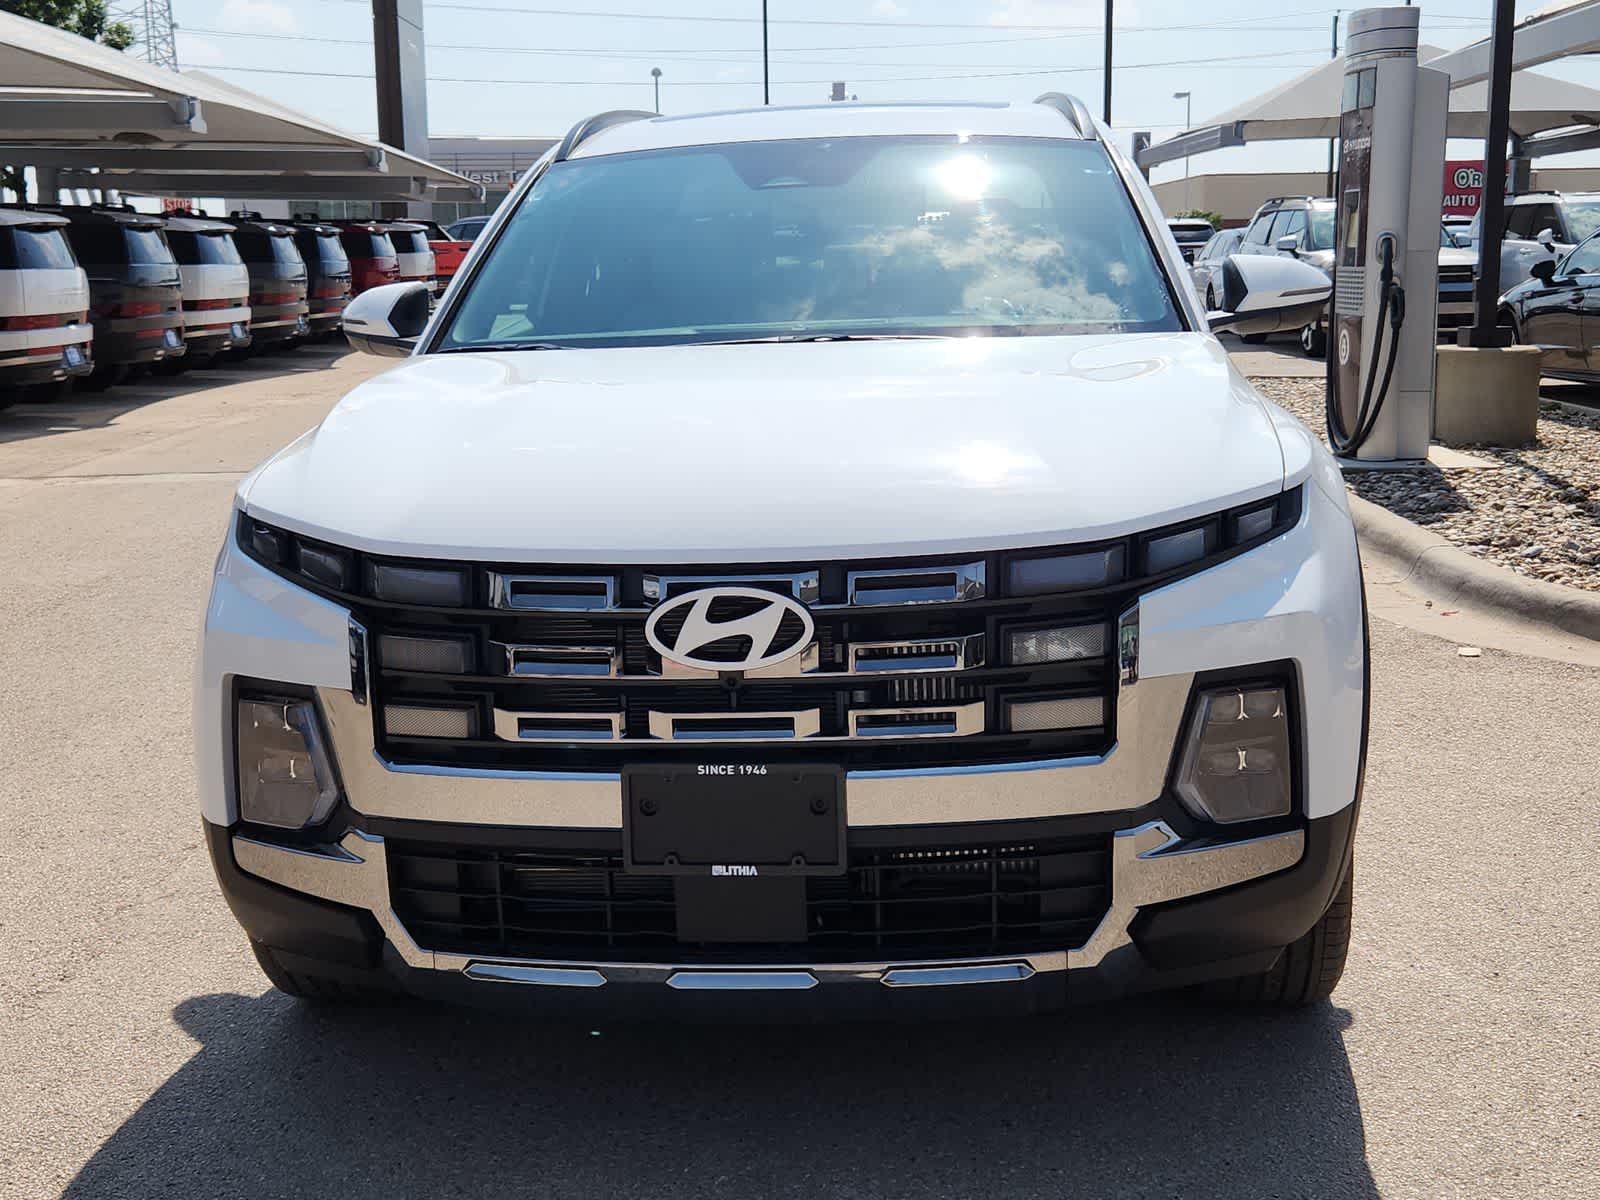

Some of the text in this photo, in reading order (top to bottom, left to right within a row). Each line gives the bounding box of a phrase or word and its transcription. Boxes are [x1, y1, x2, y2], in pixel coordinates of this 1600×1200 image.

[166, 198, 192, 211] STOP
[1443, 194, 1476, 207] AUTO
[697, 764, 768, 775] SINCE 1946
[722, 865, 758, 876] LITHIA
